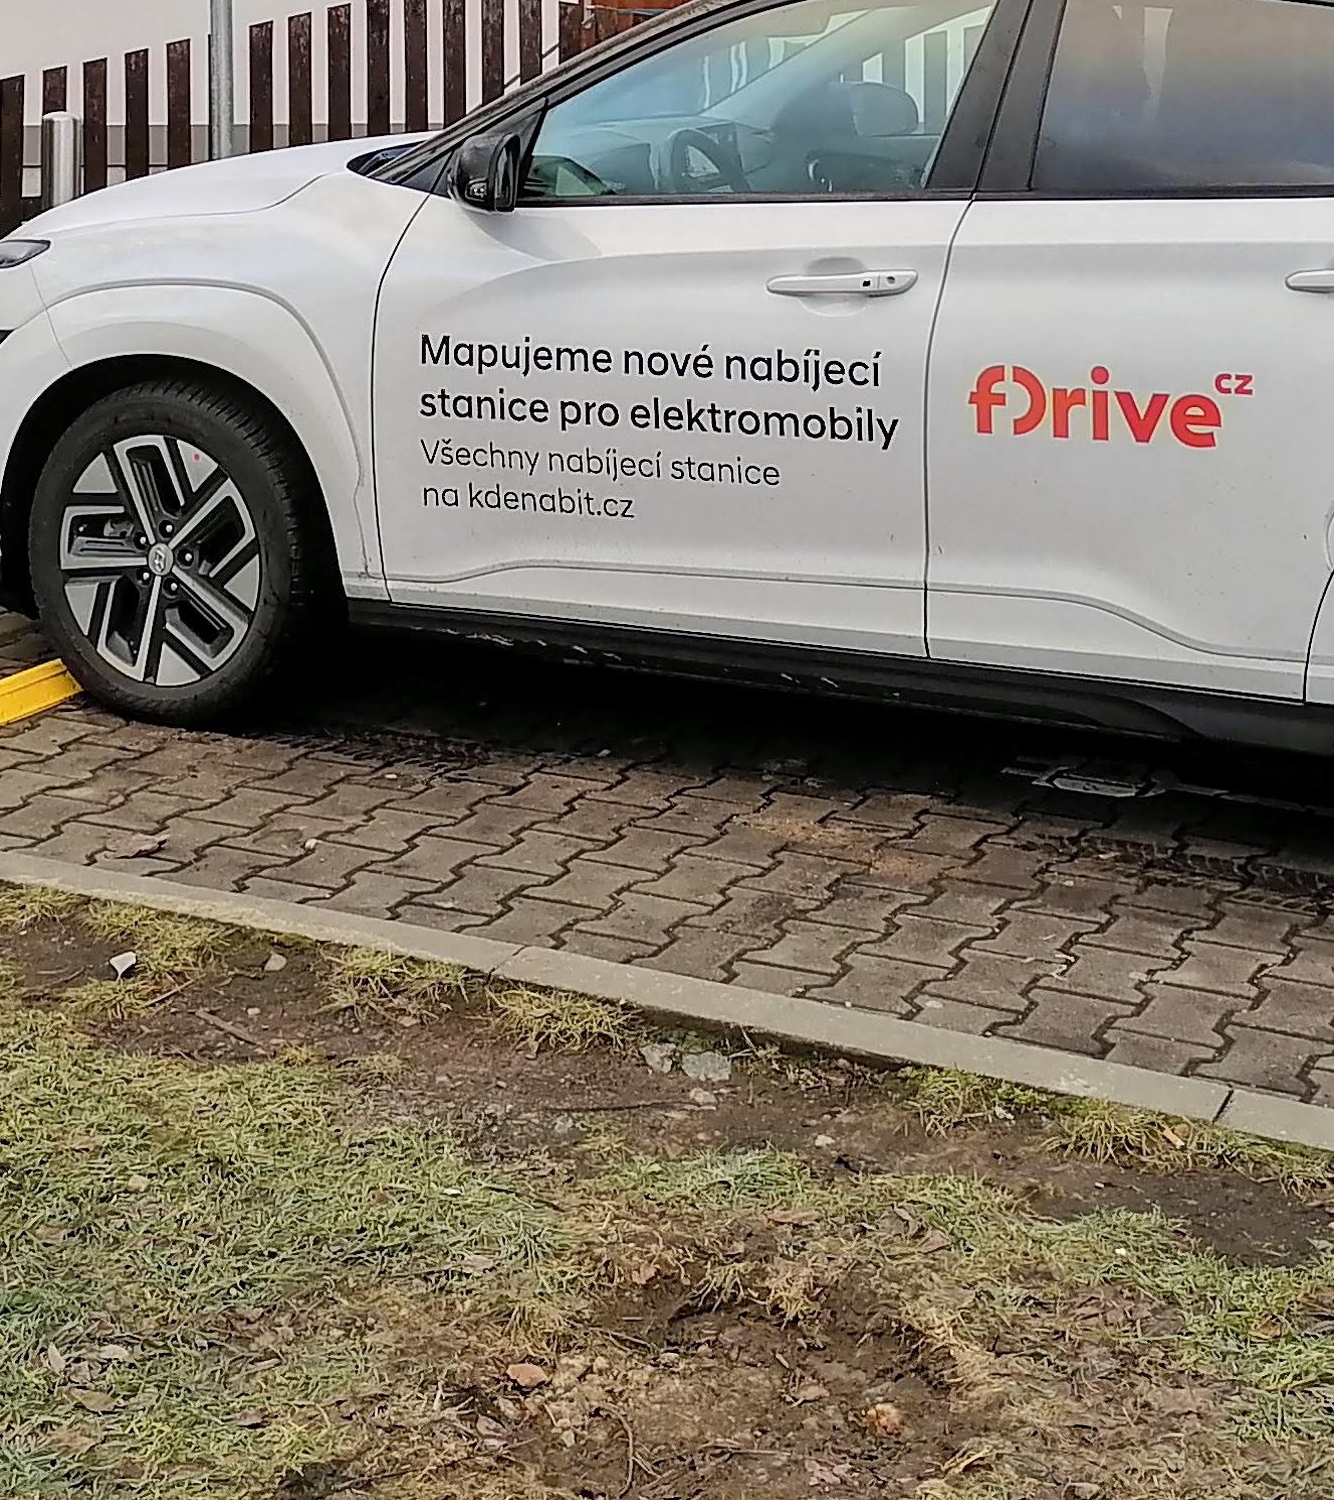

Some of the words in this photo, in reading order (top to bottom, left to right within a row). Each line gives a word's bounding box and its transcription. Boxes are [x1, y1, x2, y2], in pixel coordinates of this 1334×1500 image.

[420, 334, 613, 377] Mapujeme
[624, 344, 714, 378] nové
[725, 348, 882, 392] nabíjecí
[420, 388, 549, 422] stanice
[560, 400, 619, 431] pro
[630, 397, 899, 450] elektromobily
[420, 438, 539, 476] Všechny
[548, 447, 662, 482] nabíjecí
[671, 456, 780, 485] stanice
[423, 486, 459, 507] na
[468, 482, 635, 518] kdenabit.cz
